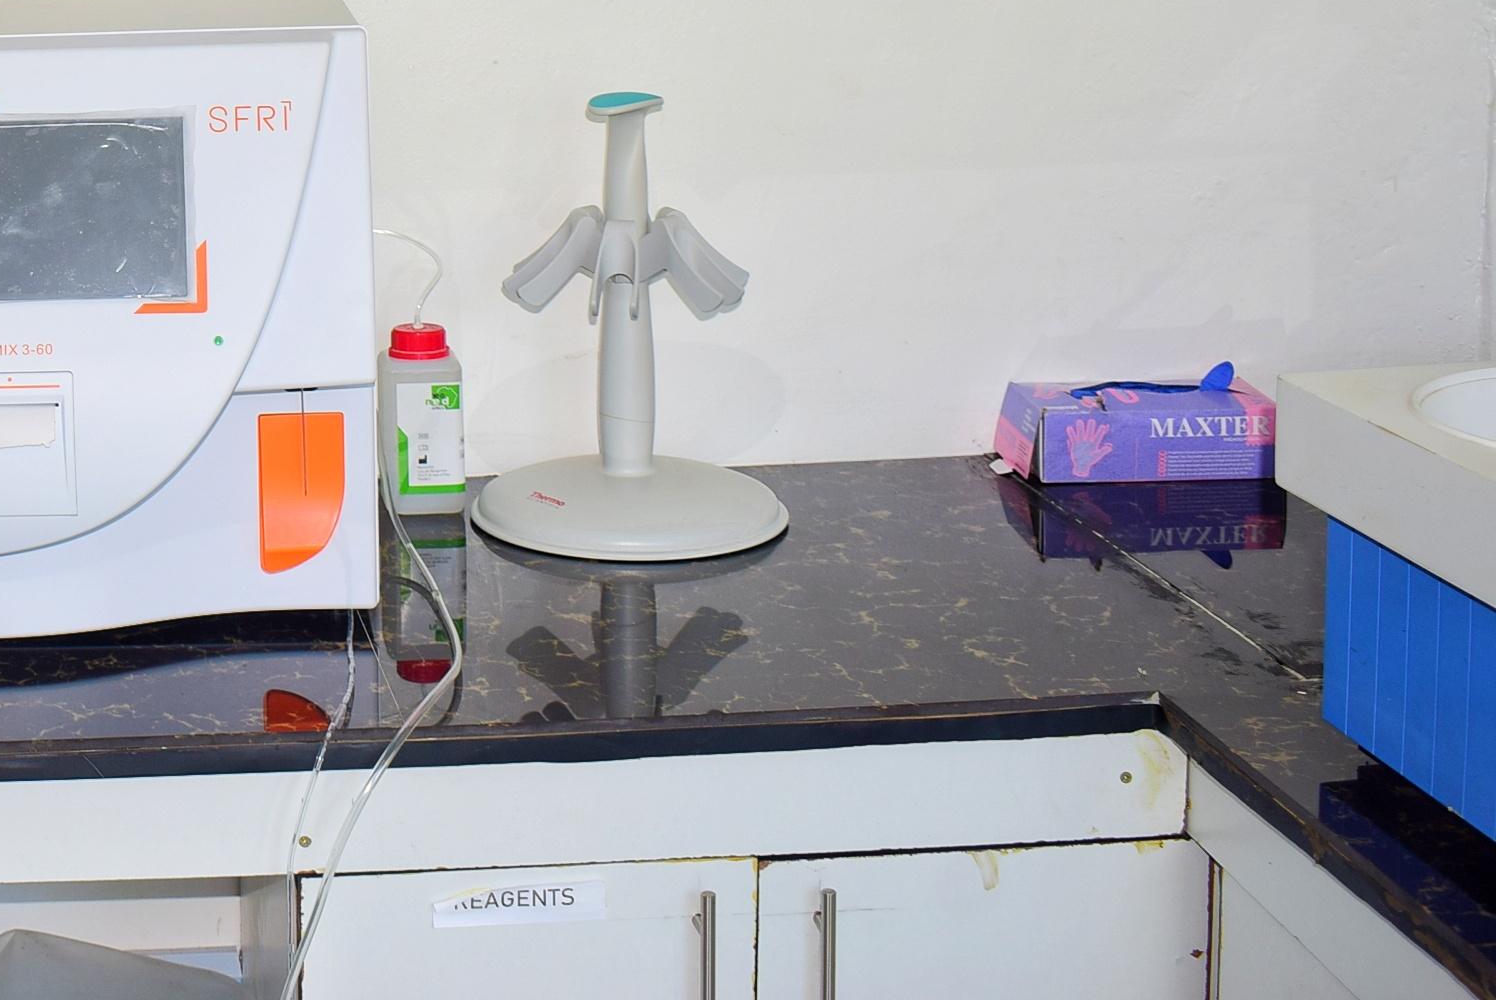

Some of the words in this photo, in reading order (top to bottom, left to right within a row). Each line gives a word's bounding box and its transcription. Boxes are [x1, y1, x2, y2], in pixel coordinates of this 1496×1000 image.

[209, 100, 291, 132] SFRI
[22, 344, 53, 356] 3-60
[1150, 416, 1270, 438] MAXTER
[534, 491, 565, 506] Thermo
